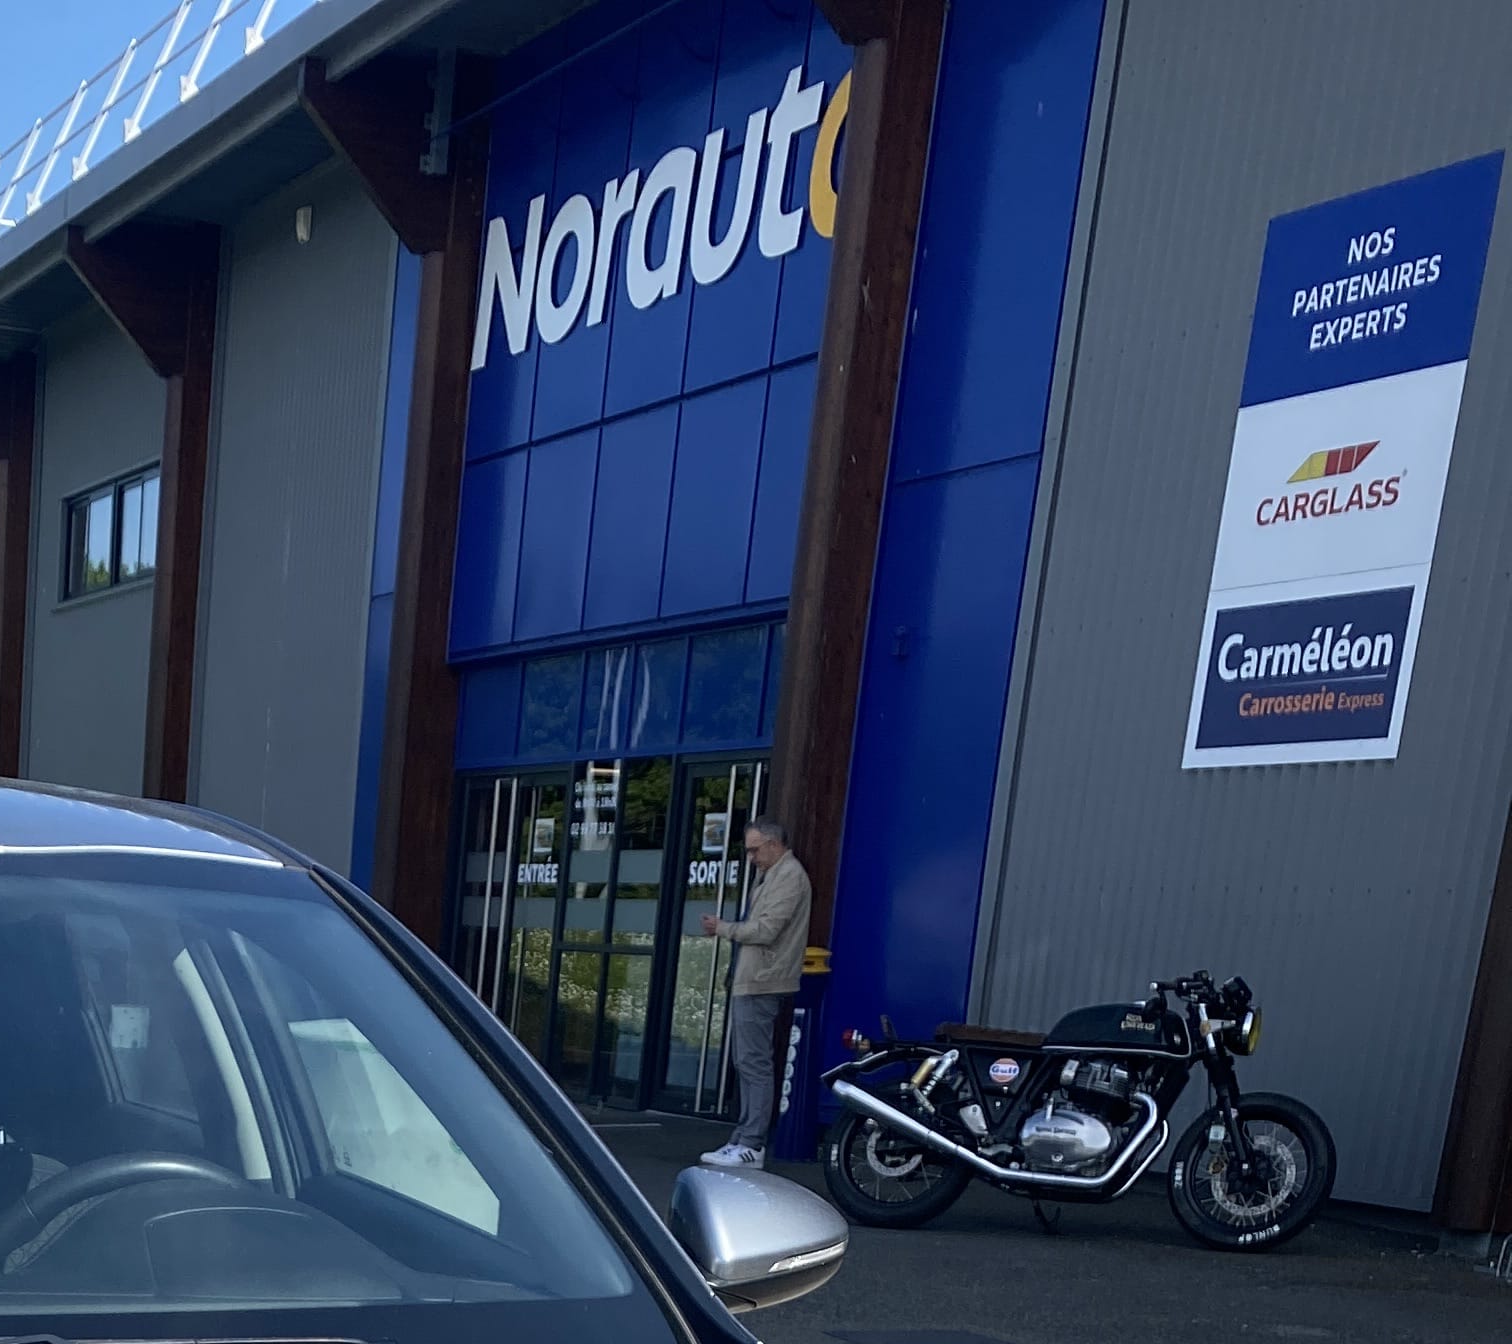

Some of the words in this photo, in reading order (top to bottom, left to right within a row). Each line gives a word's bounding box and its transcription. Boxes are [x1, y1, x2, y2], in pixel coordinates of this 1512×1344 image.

[1347, 227, 1396, 264] NOS
[1292, 254, 1442, 317] PARTENAIRES
[1309, 302, 1408, 350] EXPERTS
[1256, 476, 1401, 526] CARGLASS
[1218, 623, 1394, 682] Carméléon
[1239, 686, 1335, 717] Carrosserie
[1337, 692, 1385, 714] Express
[517, 856, 559, 883] ENTRÉE
